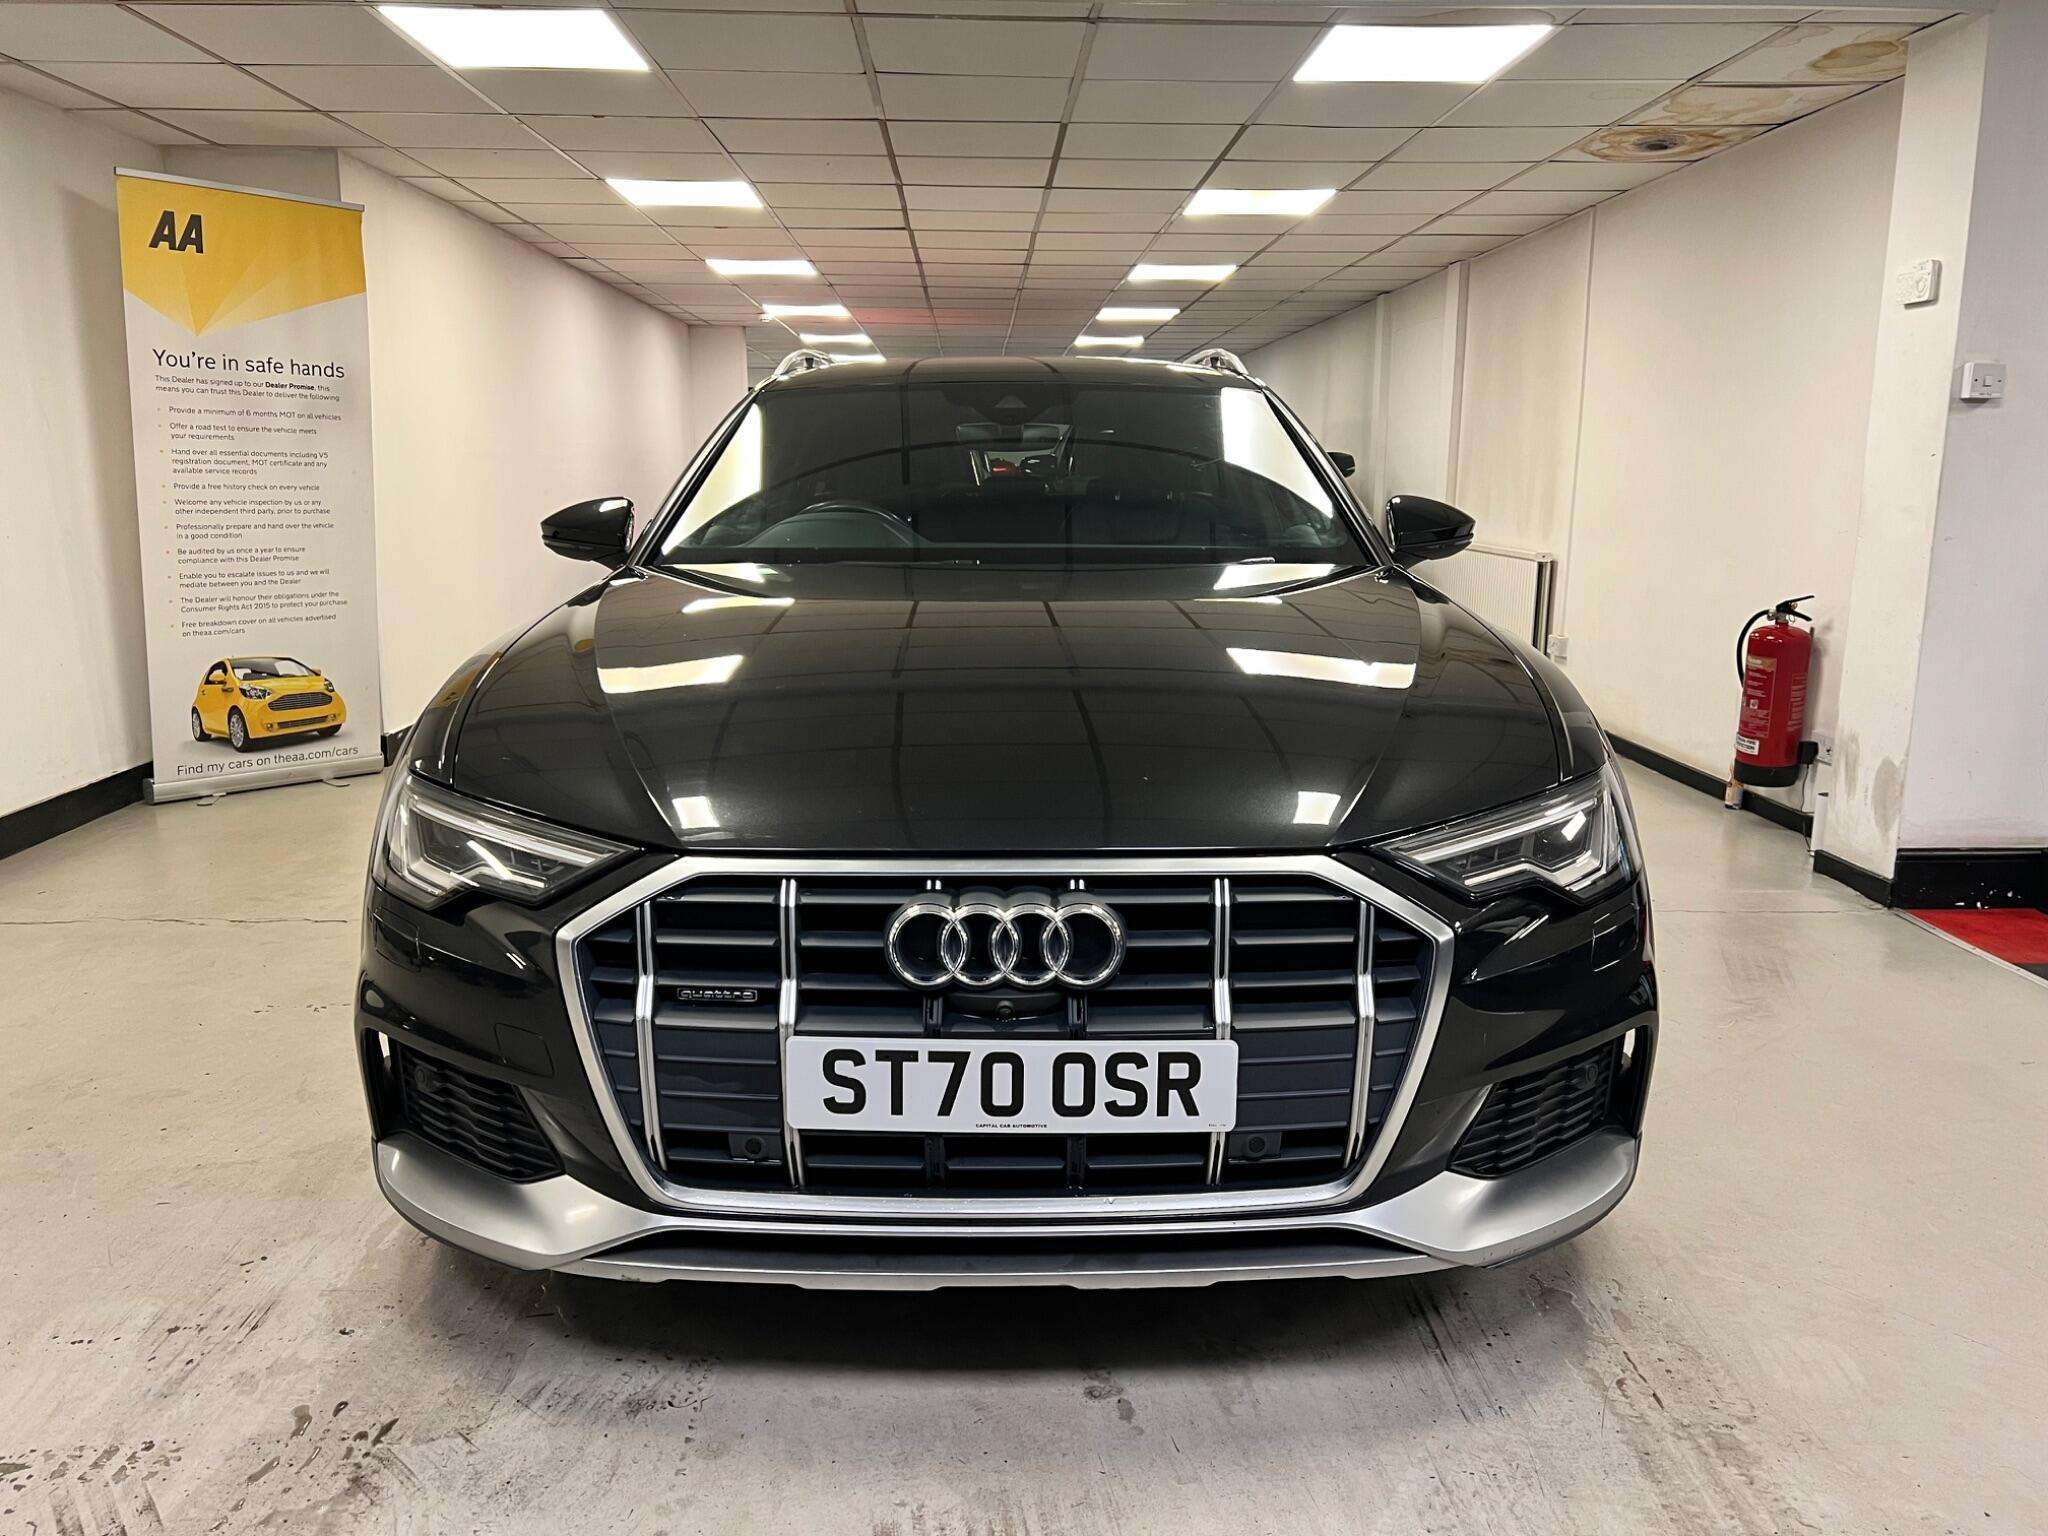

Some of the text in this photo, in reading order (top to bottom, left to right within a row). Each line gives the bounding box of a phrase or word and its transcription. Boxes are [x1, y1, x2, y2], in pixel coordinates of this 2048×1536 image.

[149, 209, 204, 254] AA
[153, 349, 345, 378] You're in safe hands
[172, 376, 194, 384] Dealer
[210, 379, 233, 387] signed
[265, 381, 287, 390] Dealer
[211, 387, 227, 395] trust
[229, 388, 241, 396] this
[243, 389, 264, 397] Dealer
[274, 391, 297, 399] deliver
[310, 392, 340, 402] following
[169, 405, 195, 414] Provide
[204, 407, 236, 416] minimum
[253, 409, 278, 418] months
[280, 410, 295, 418] MOT
[314, 413, 341, 421] vehicles
[170, 422, 188, 430] Offer
[196, 423, 211, 431] road
[229, 424, 235, 432] to
[261, 425, 272, 433] the
[273, 426, 297, 434] vehicle
[171, 432, 186, 440] your
[172, 448, 190, 456] Hand
[219, 449, 249, 457] essential
[251, 450, 287, 458] documents
[289, 451, 317, 459] including
[172, 458, 212, 466] registration
[174, 482, 199, 490] Provide
[223, 483, 246, 491] history
[248, 483, 267, 491] check
[175, 498, 207, 506] Welcome
[249, 499, 282, 507] inspection
[284, 499, 292, 507] by
[195, 507, 239, 516] independent
[277, 507, 292, 515] prior
[303, 507, 330, 515] purchase
[176, 523, 224, 531] Professionally
[189, 547, 215, 555] audited
[217, 547, 225, 556] by
[260, 547, 274, 555] year
[178, 556, 218, 565] compliance
[250, 555, 271, 563] Dealer
[180, 572, 202, 580] Enable
[280, 577, 301, 585] Dealer
[181, 596, 193, 604] The
[195, 596, 217, 604] Dealer
[233, 594, 256, 602] honour
[274, 592, 310, 601] obligations
[311, 591, 327, 599] under
[181, 605, 216, 613] Consumer
[218, 604, 240, 612] Rights
[280, 601, 303, 609] protect
[319, 599, 348, 607] purchase
[182, 620, 197, 628] Free
[199, 619, 236, 628] breakdown
[306, 614, 336, 622] advertised
[178, 745, 359, 776] Find my cars on theaa.com/cars
[680, 990, 754, 1000] quattro
[822, 1048, 1202, 1118] ST70 OSR
